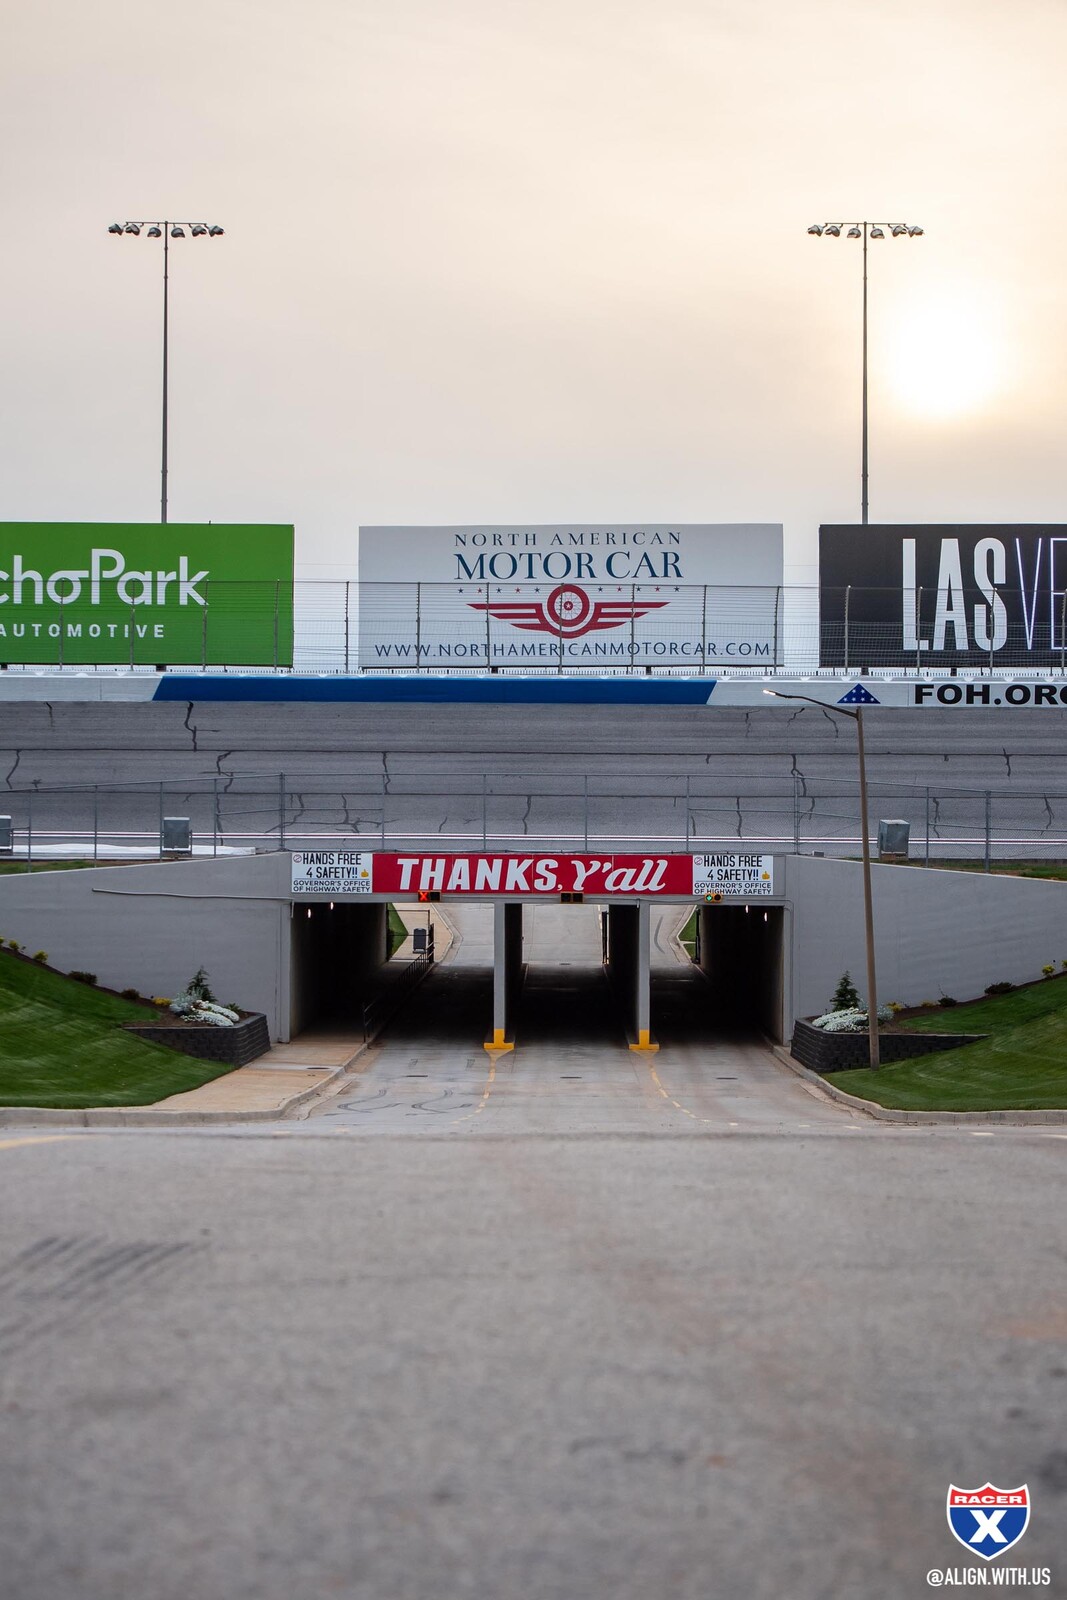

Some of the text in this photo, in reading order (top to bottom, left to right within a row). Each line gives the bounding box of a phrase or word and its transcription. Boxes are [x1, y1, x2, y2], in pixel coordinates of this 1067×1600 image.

[454, 531, 682, 547] NORTH AMERICAN
[453, 550, 684, 581] MOTOR CAR
[902, 537, 1007, 652] LAS
[374, 641, 771, 658] WWW.NORTHAMERICANMOTORCAR.COM
[302, 852, 362, 865] HANDS FREE
[703, 855, 763, 868] HANDS FREE
[306, 866, 358, 879] 4 SAFETY!!
[397, 858, 669, 892] THANKS, Y'all
[707, 868, 759, 881] 4 SAFETY!!
